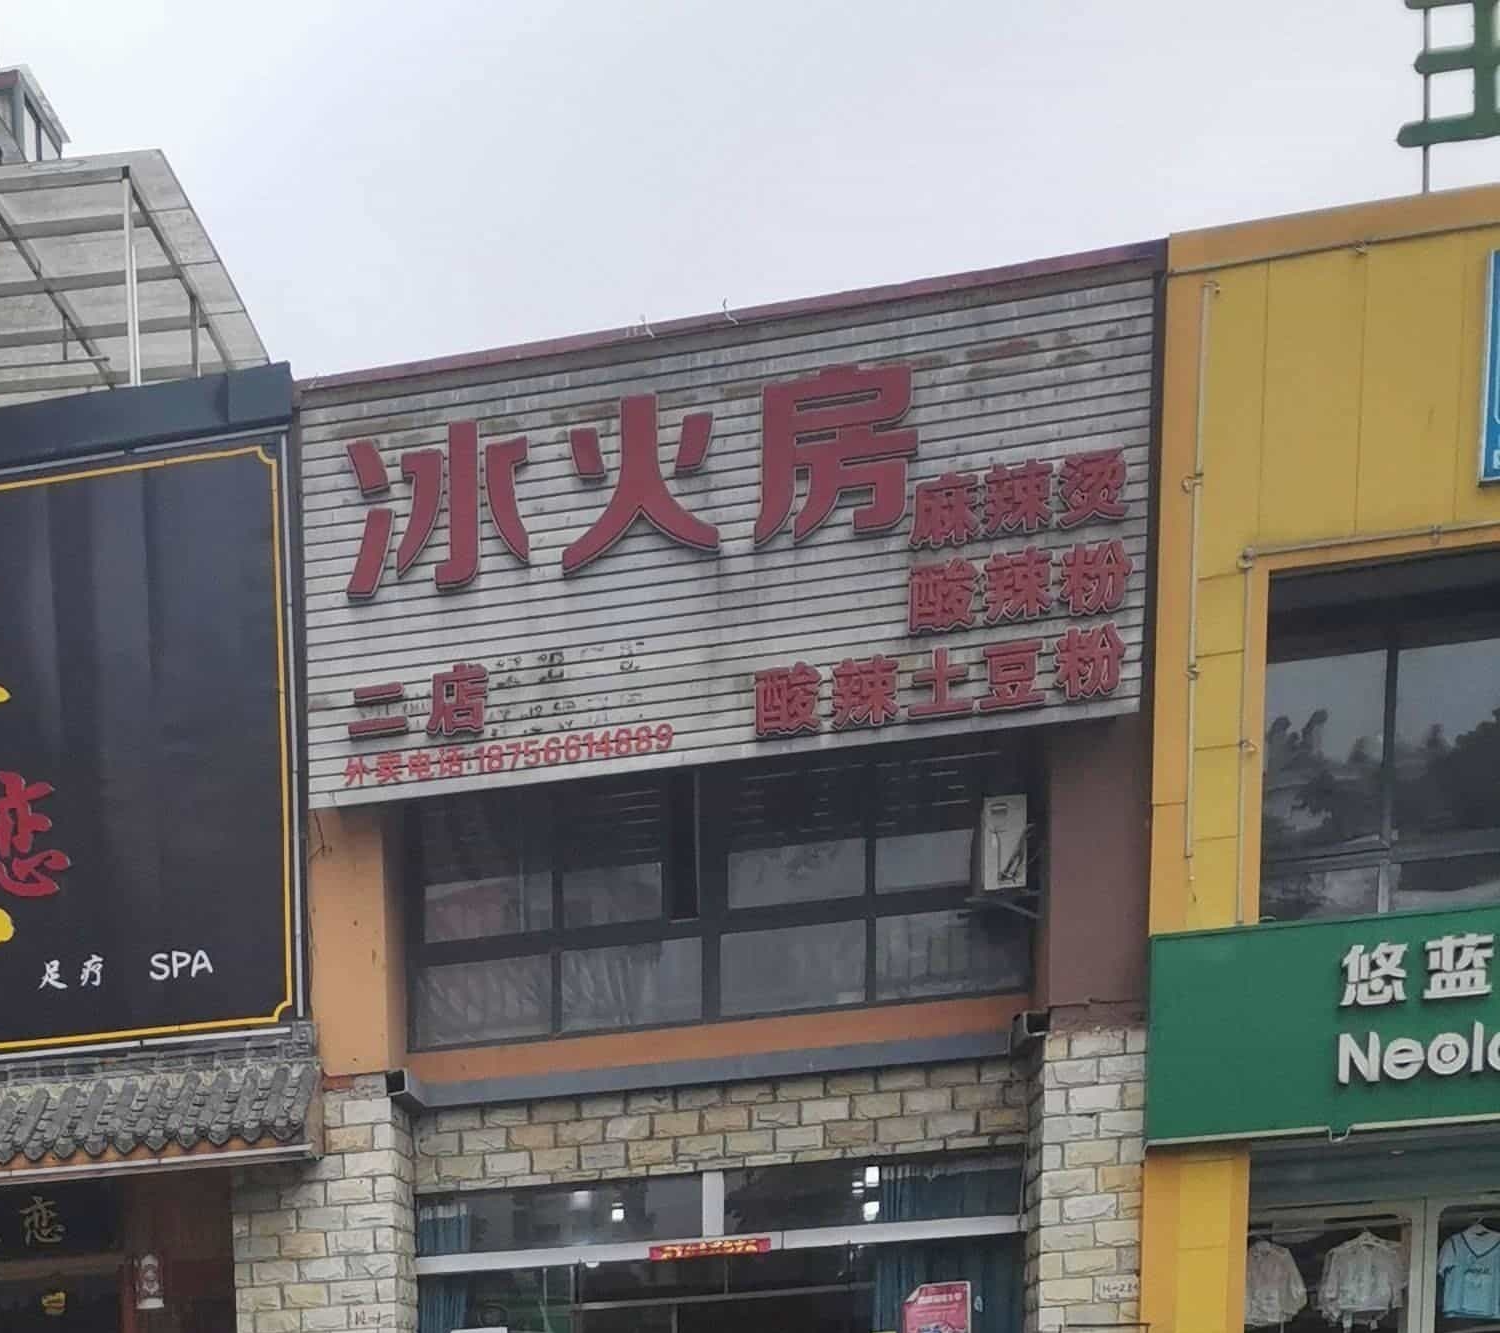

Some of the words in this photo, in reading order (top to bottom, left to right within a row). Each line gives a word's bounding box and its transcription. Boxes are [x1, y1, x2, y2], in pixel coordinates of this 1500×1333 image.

[346, 362, 920, 600] 冰火房
[908, 446, 1132, 549] 麻辣烫
[907, 537, 1134, 635] 酸辣粉
[347, 661, 492, 740] 二店
[753, 619, 1127, 740] 酸辣土豆粉
[38, 954, 105, 990] 足疗
[149, 949, 214, 981] SPA
[1338, 932, 1495, 1007] 悠蓝
